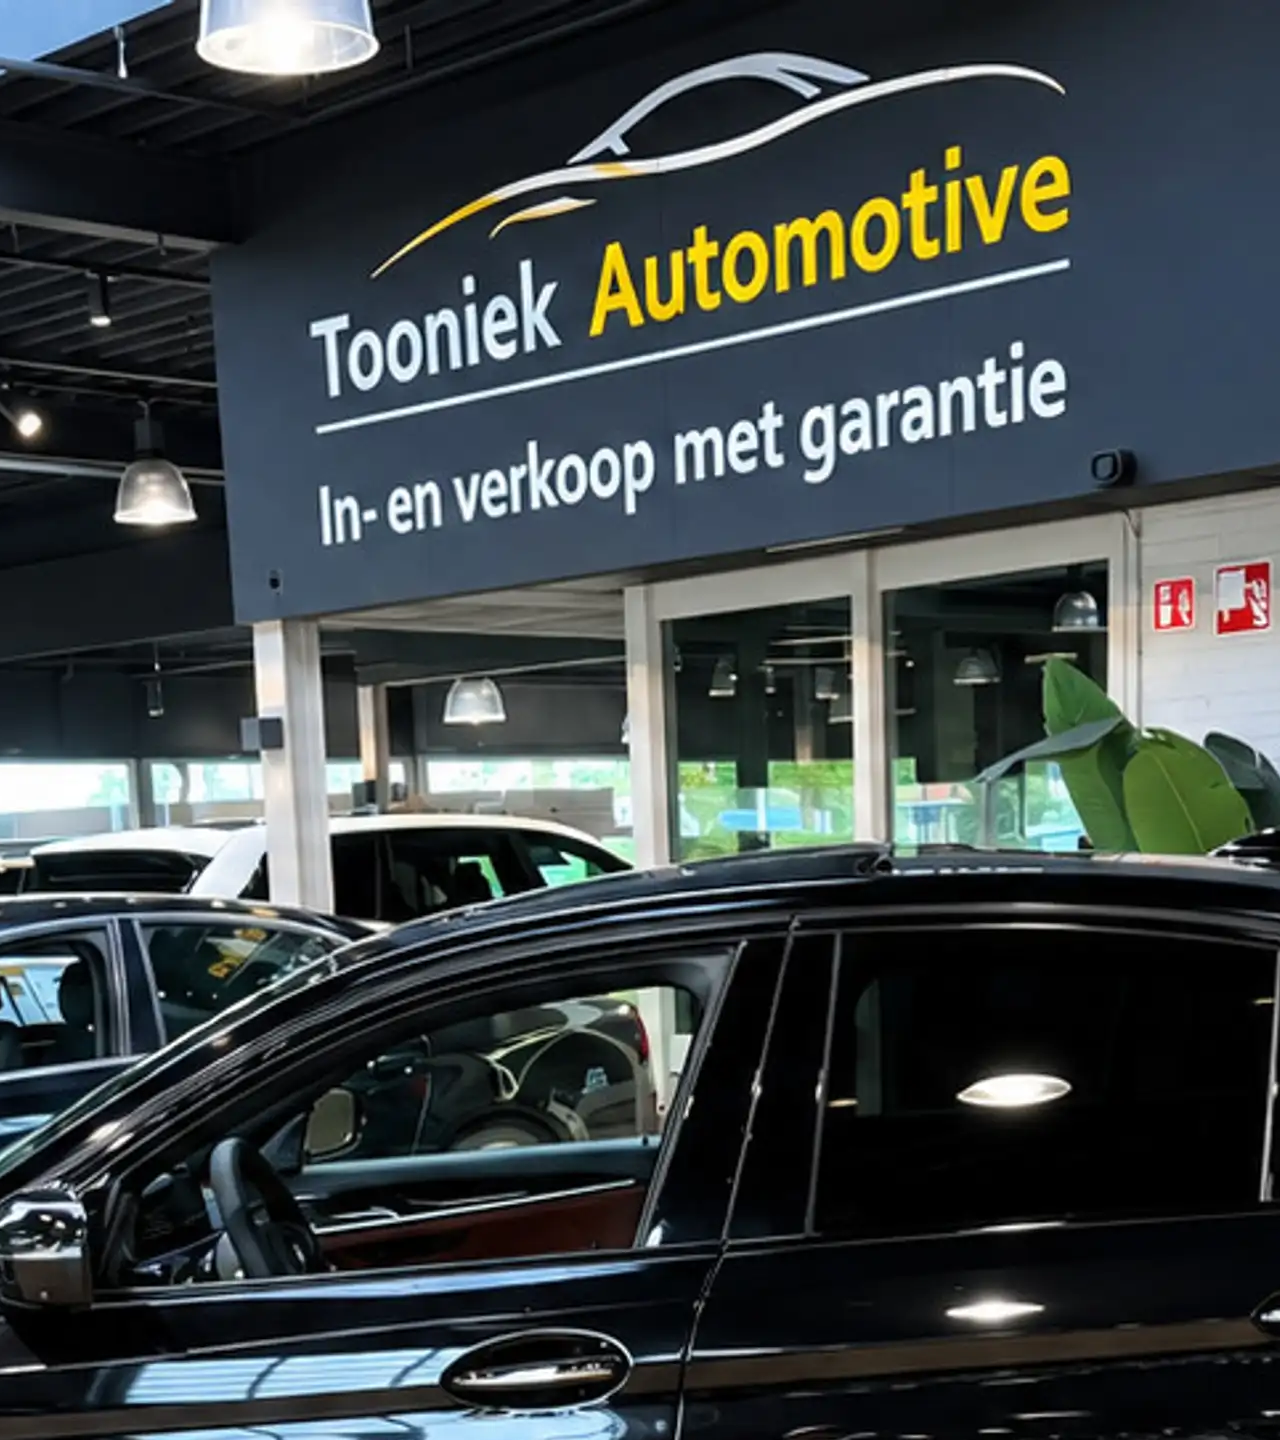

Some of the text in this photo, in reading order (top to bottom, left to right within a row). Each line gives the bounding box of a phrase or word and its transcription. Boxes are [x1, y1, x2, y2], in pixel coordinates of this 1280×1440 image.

[309, 145, 1071, 399] Tooniek Automotive
[319, 340, 1067, 547] In- en verkoop met garantie
